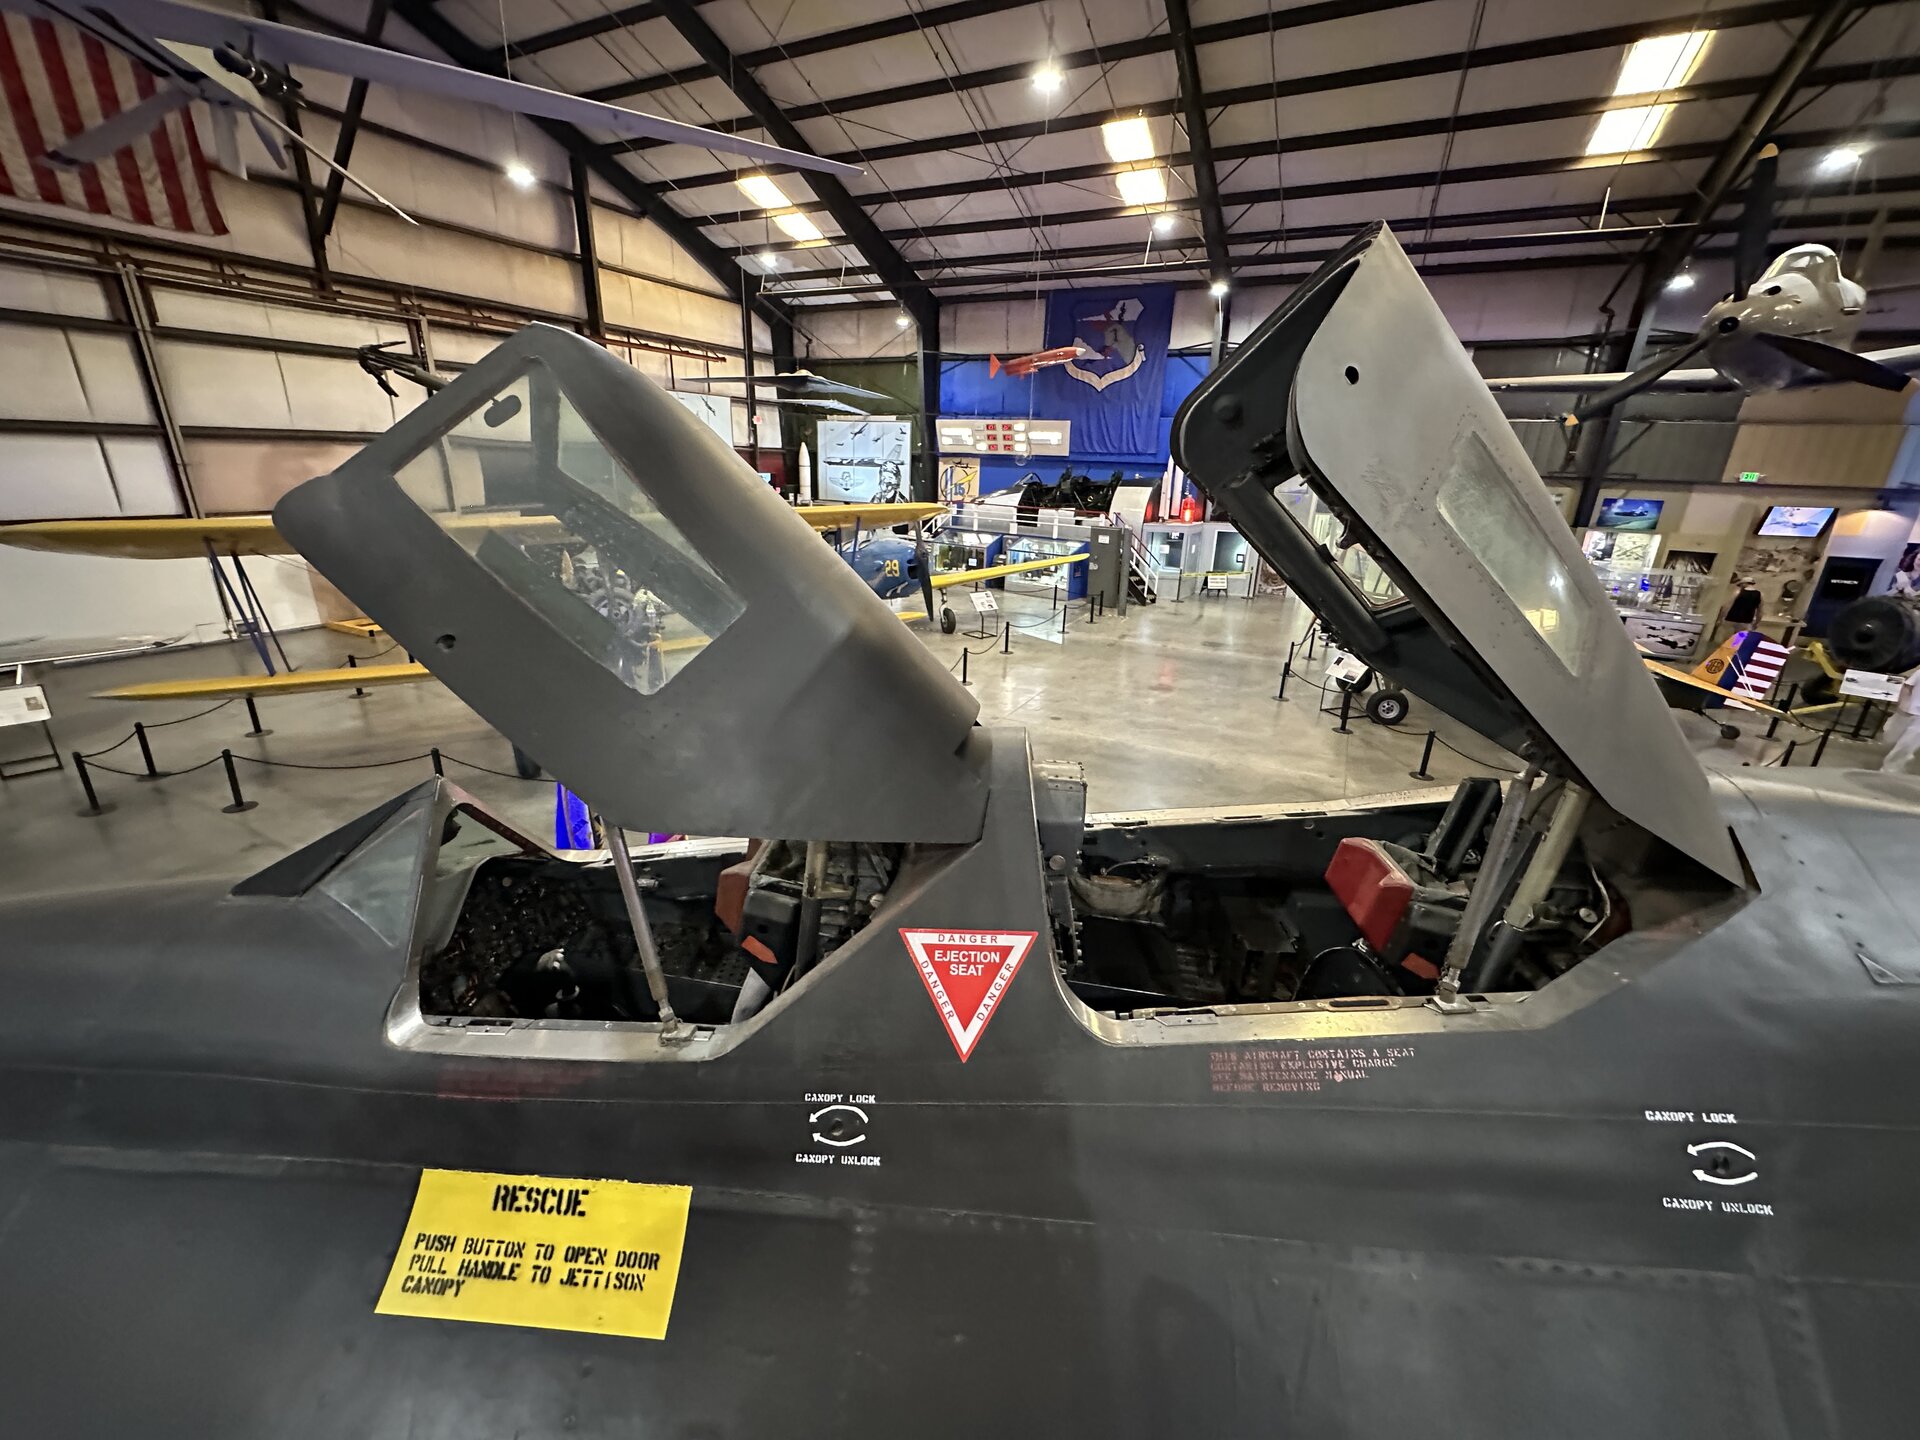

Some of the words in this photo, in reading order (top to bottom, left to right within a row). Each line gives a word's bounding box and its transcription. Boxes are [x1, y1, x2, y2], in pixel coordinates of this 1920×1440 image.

[885, 559, 900, 577] 29
[938, 934, 998, 944] DANGER
[934, 950, 1000, 963] EJECTION
[949, 964, 984, 976] SEAT
[920, 960, 954, 1020] DANGER
[976, 962, 1014, 1021] DANGER
[1245, 1050, 1300, 1060] AIRCRAFT
[1308, 1048, 1364, 1060] CONTAINS
[1372, 1048, 1380, 1058] A
[1387, 1047, 1415, 1058] SEAT
[1281, 1059, 1345, 1070] EXPLOSIVE
[1353, 1058, 1398, 1069] CHARGE
[1325, 1069, 1370, 1081] MANUAL
[1263, 1081, 1321, 1092] REMOVING
[804, 1092, 843, 1103] CANOPY
[849, 1094, 876, 1104] LOCK
[1644, 1110, 1695, 1122] CANOPY
[1702, 1112, 1737, 1124] LOCK
[795, 1153, 835, 1164] CANOPY
[841, 1155, 881, 1166] UNLOCK
[492, 1184, 590, 1217] RESCUE
[1662, 1197, 1713, 1211] CANOPY
[1721, 1201, 1774, 1216] UNLOCK
[414, 1232, 457, 1253] PUSH
[463, 1238, 526, 1259] BUTTON
[535, 1244, 555, 1261] TO
[564, 1246, 608, 1266] OPEN
[615, 1250, 660, 1270] DOOR
[408, 1254, 447, 1275] PULL
[458, 1259, 521, 1282] HANDLE
[531, 1265, 552, 1283] TO
[560, 1268, 646, 1292] JETTISON
[401, 1275, 466, 1298] CANOPY
